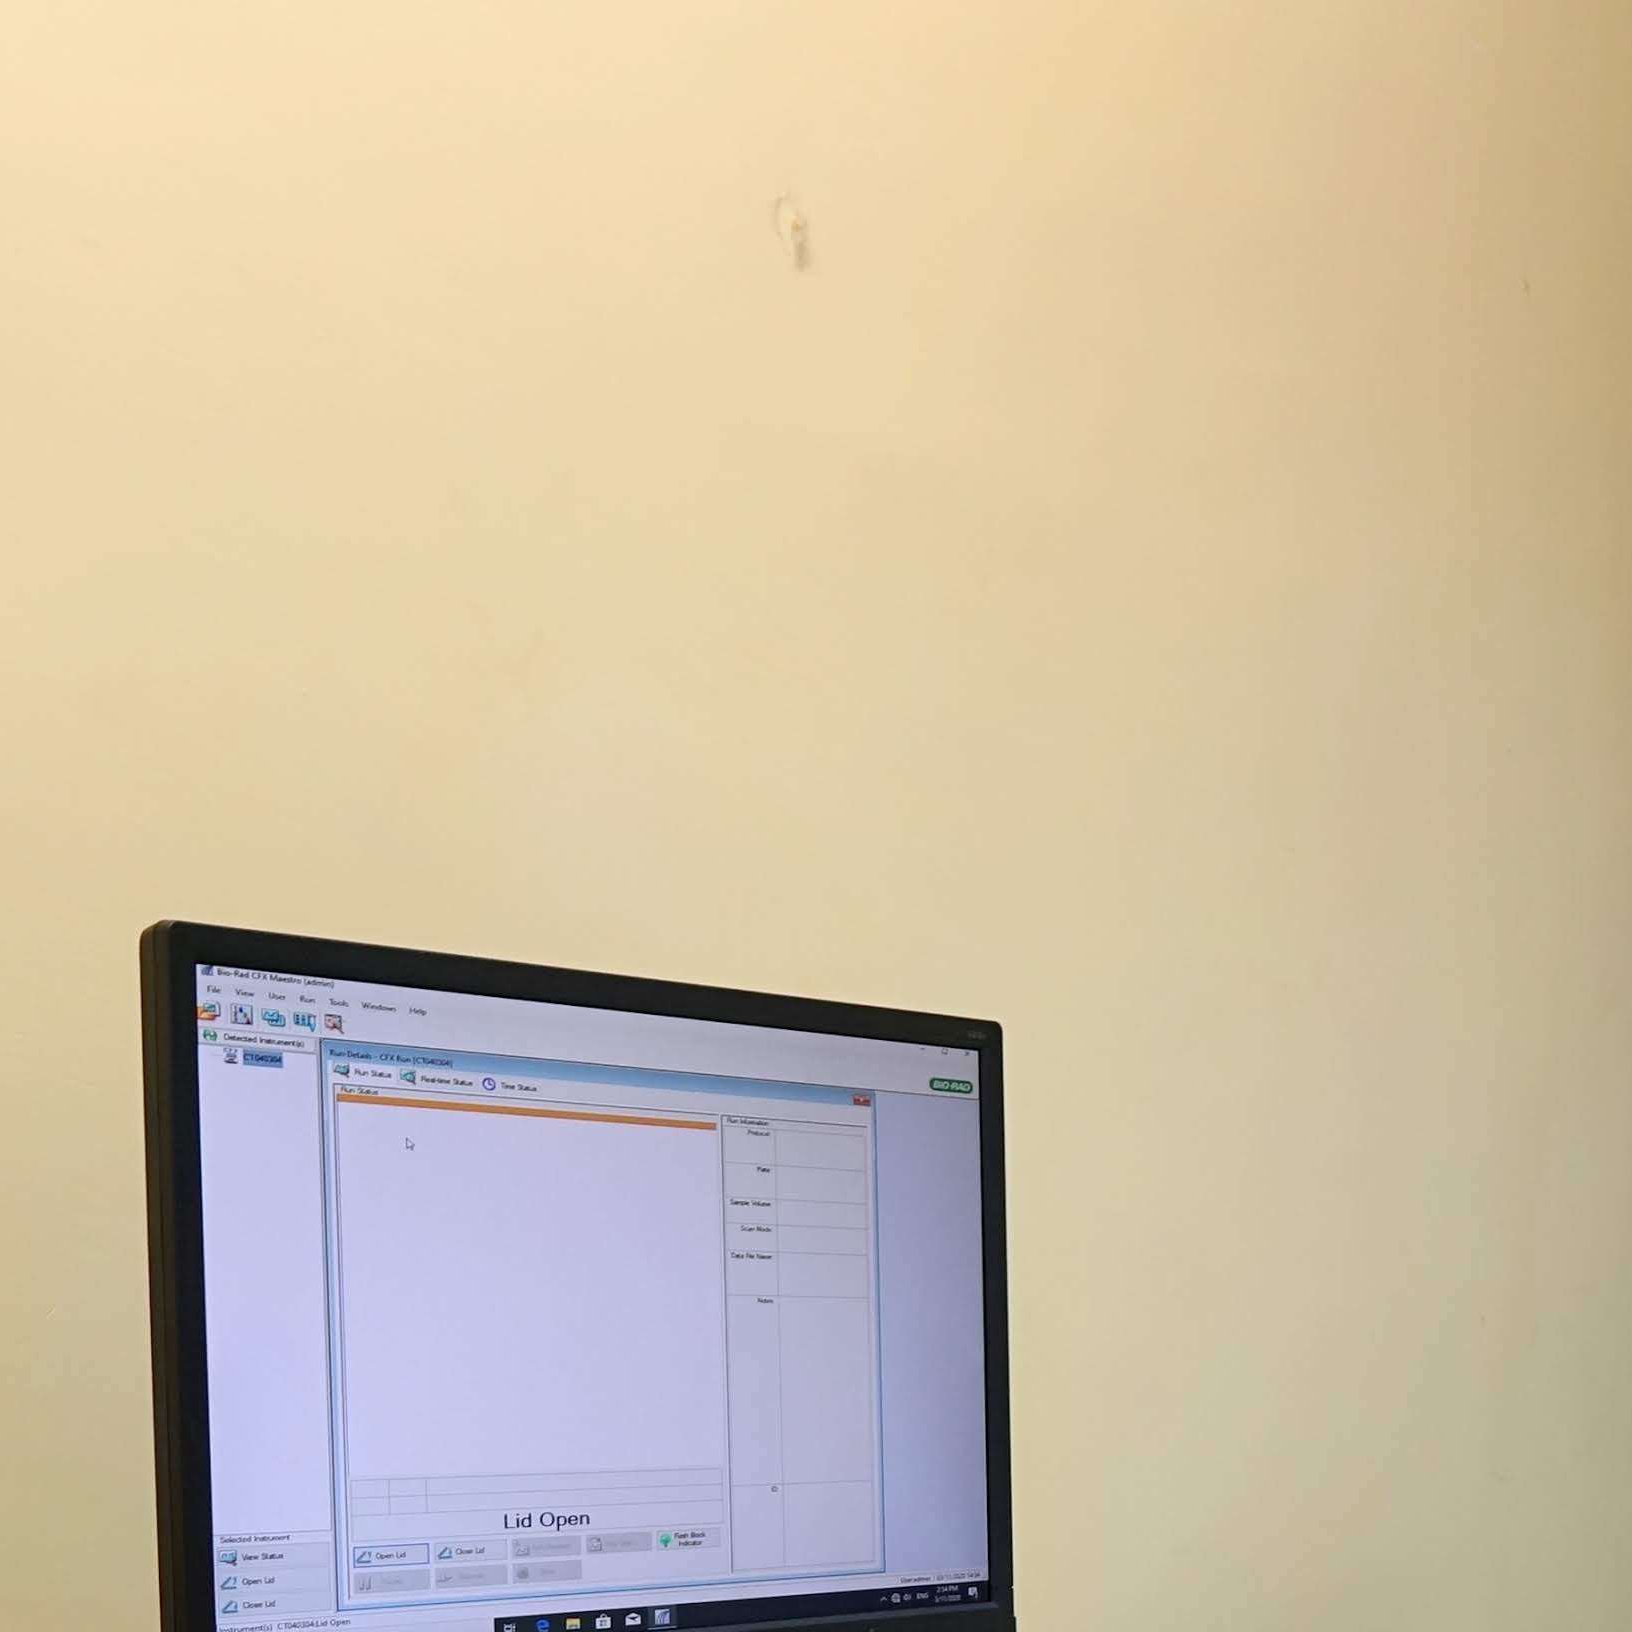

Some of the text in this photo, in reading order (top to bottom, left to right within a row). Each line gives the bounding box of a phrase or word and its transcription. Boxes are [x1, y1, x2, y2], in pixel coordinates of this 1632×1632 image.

[217, 968, 249, 979] Bio-Rad
[251, 972, 267, 981] CFX
[270, 974, 301, 985] Maestro
[207, 985, 221, 994] File
[235, 989, 255, 998] View
[269, 992, 286, 1001] User
[300, 995, 316, 1004] Run
[329, 998, 349, 1008] Tools
[409, 1007, 427, 1017] Help
[223, 1032, 257, 1044] Detected
[354, 1068, 392, 1079] Run Status
[453, 1078, 474, 1088] Status
[504, 1511, 591, 1532] Lid Open
[220, 1534, 290, 1544] Selected Instrument
[375, 1551, 406, 1561] Open Lid
[455, 1546, 485, 1556] Close Lid
[241, 1552, 284, 1562] View Status
[242, 1576, 275, 1587] Open Lid
[243, 1600, 276, 1609] Close Lid
[330, 1618, 351, 1628] Open
